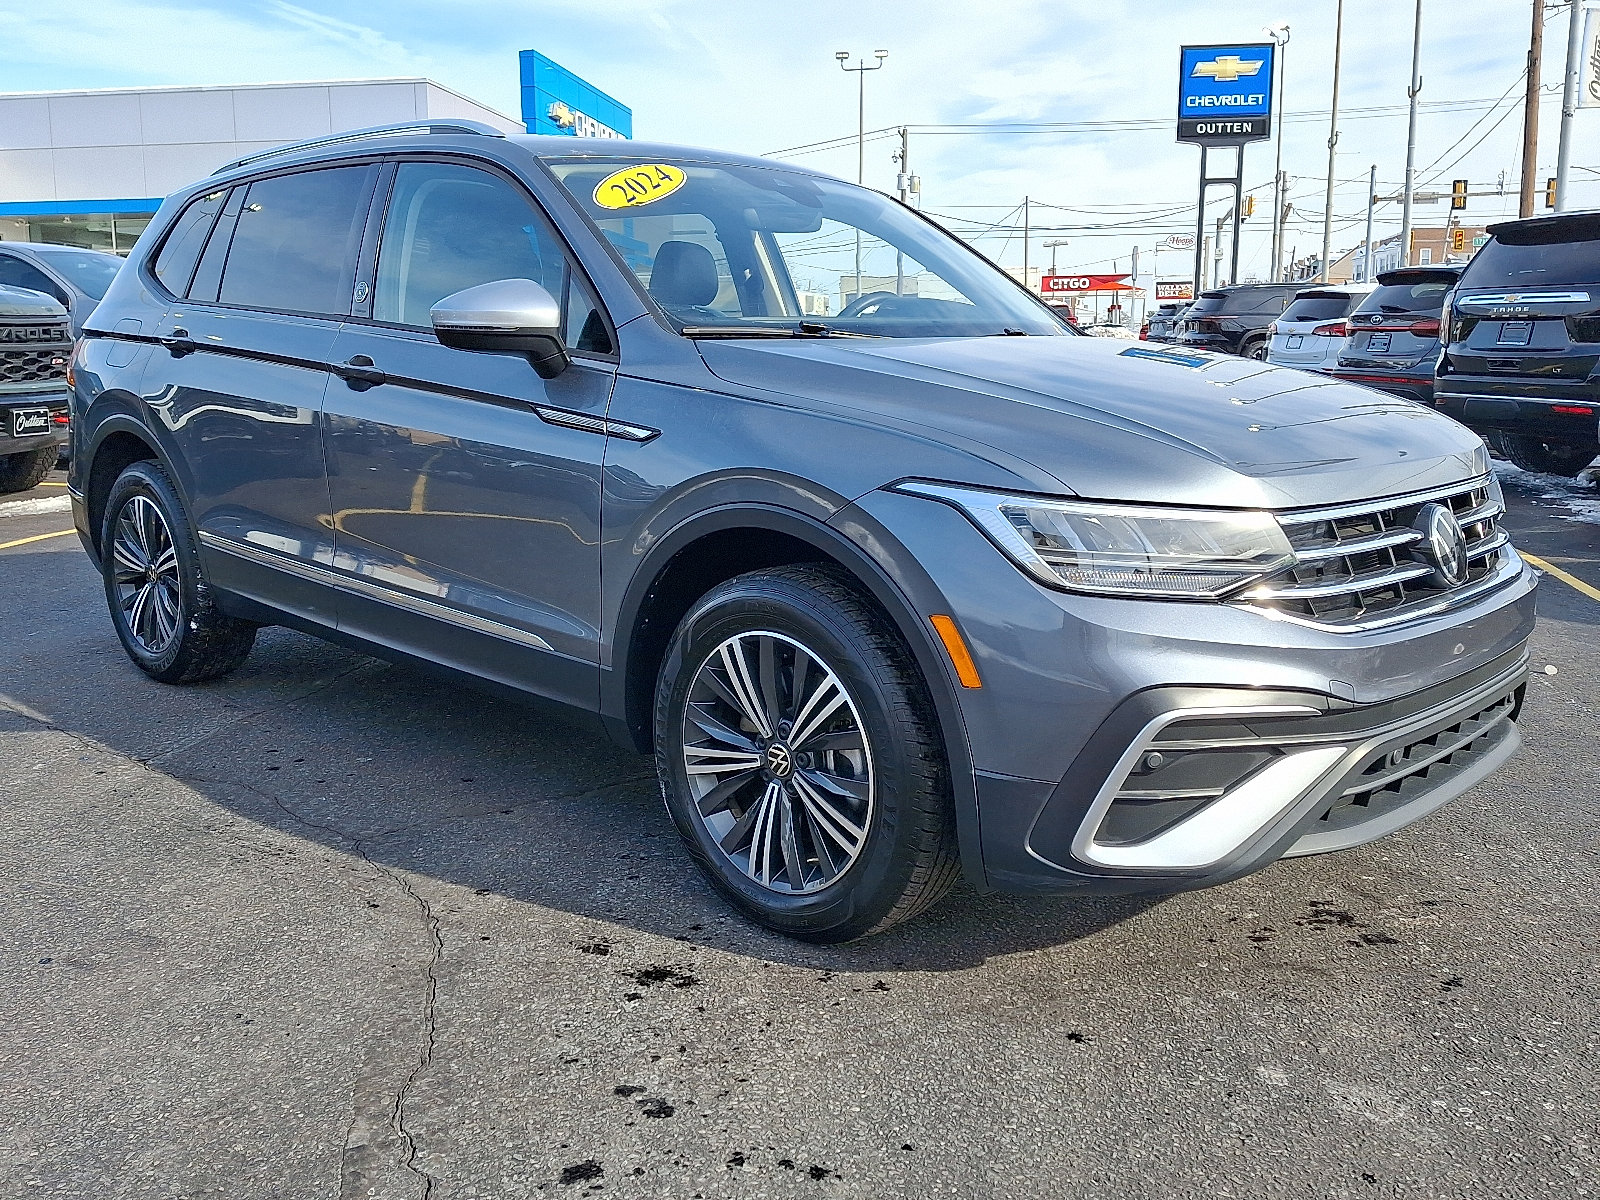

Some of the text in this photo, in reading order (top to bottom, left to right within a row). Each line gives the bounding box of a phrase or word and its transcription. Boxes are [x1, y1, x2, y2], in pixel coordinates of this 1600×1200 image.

[1186, 94, 1266, 107] CHEVROLET
[1196, 122, 1252, 134] OUTTEN
[610, 166, 673, 203] 2024
[1050, 278, 1090, 290] CITGO
[16, 415, 48, 432] Outten
